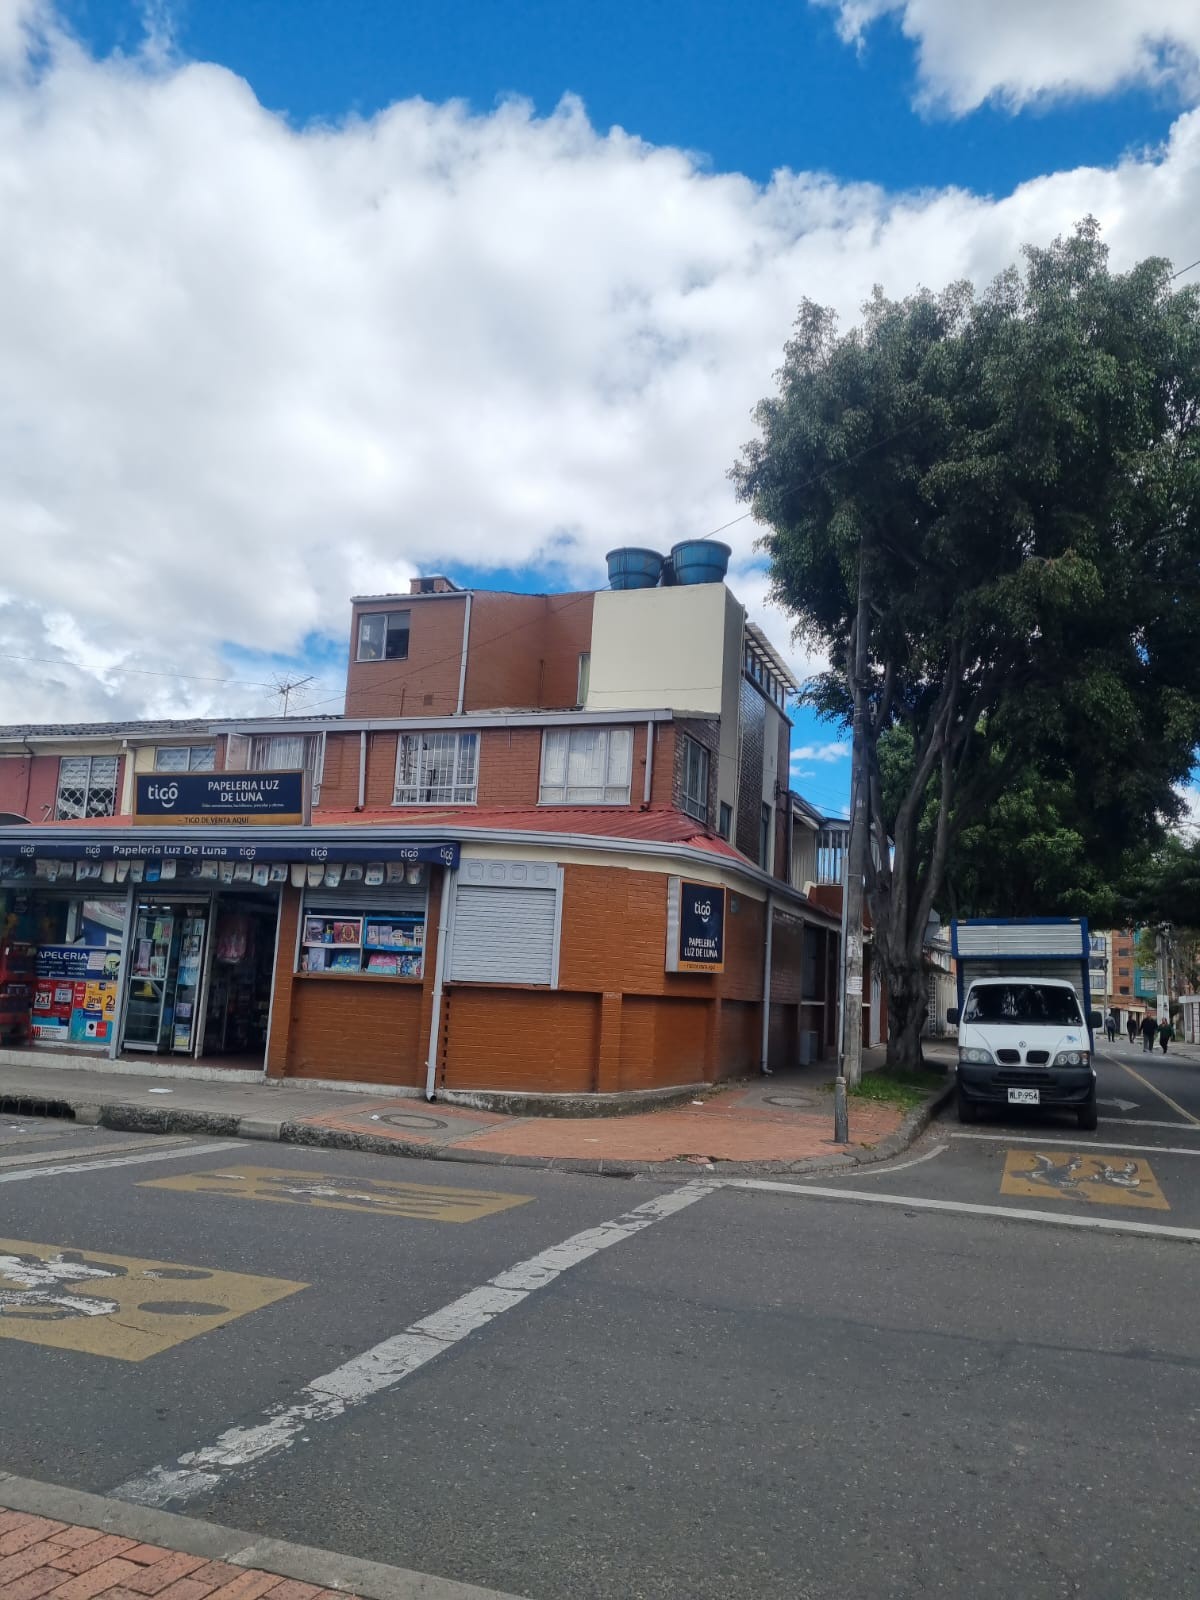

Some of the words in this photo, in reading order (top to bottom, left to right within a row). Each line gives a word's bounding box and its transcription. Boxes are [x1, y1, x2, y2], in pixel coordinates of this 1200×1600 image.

[207, 780, 258, 791] PAPELERIA
[260, 779, 280, 790] LUZ
[220, 792, 235, 802] DE
[236, 791, 263, 802] LUNA
[112, 845, 161, 856] Papeleria
[164, 845, 181, 855] Luz
[183, 845, 199, 855] De
[201, 846, 228, 856] Luna
[688, 937, 715, 948] PAPELERIA
[39, 951, 88, 960] APELERIA
[684, 947, 695, 957] LUZ
[695, 948, 703, 957] DE
[703, 949, 718, 958] LUNA
